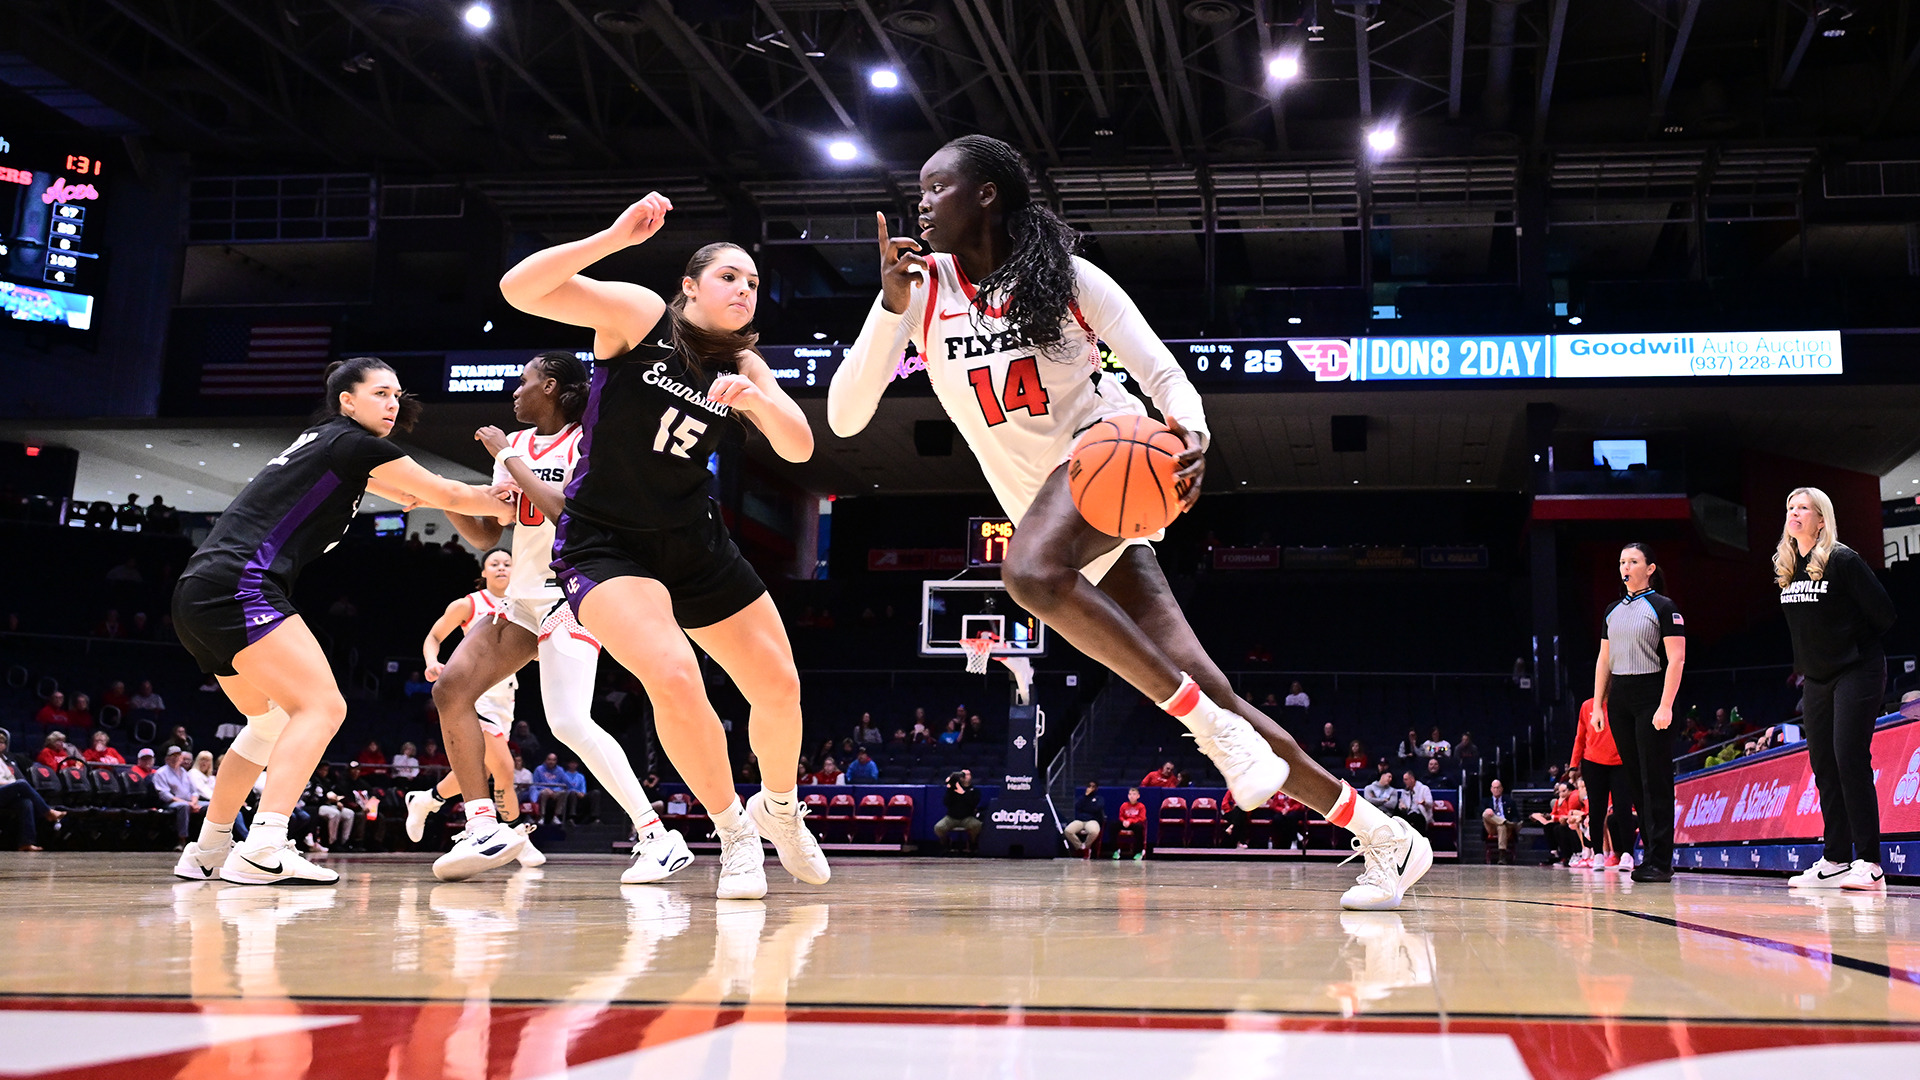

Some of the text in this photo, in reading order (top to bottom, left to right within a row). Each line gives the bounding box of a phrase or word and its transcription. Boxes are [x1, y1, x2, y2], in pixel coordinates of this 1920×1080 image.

[42, 177, 99, 204] Aces
[1190, 345, 1234, 353] FOULS TOL
[1570, 337, 1832, 355] Goodwill Auto Auction
[807, 358, 817, 371] 3
[1197, 355, 1232, 371] 0 4
[1244, 349, 1283, 373] 25
[1371, 339, 1541, 376] DON8 2DAY
[1690, 354, 1832, 374] (937) 228-AUTO
[450, 365, 525, 377] EVANSVIL
[806, 373, 817, 386] 3
[449, 379, 504, 392] DAYTON
[967, 355, 1050, 428] 14
[652, 406, 709, 459] 15
[981, 521, 1013, 538] 8:46
[985, 537, 1009, 562] 17
